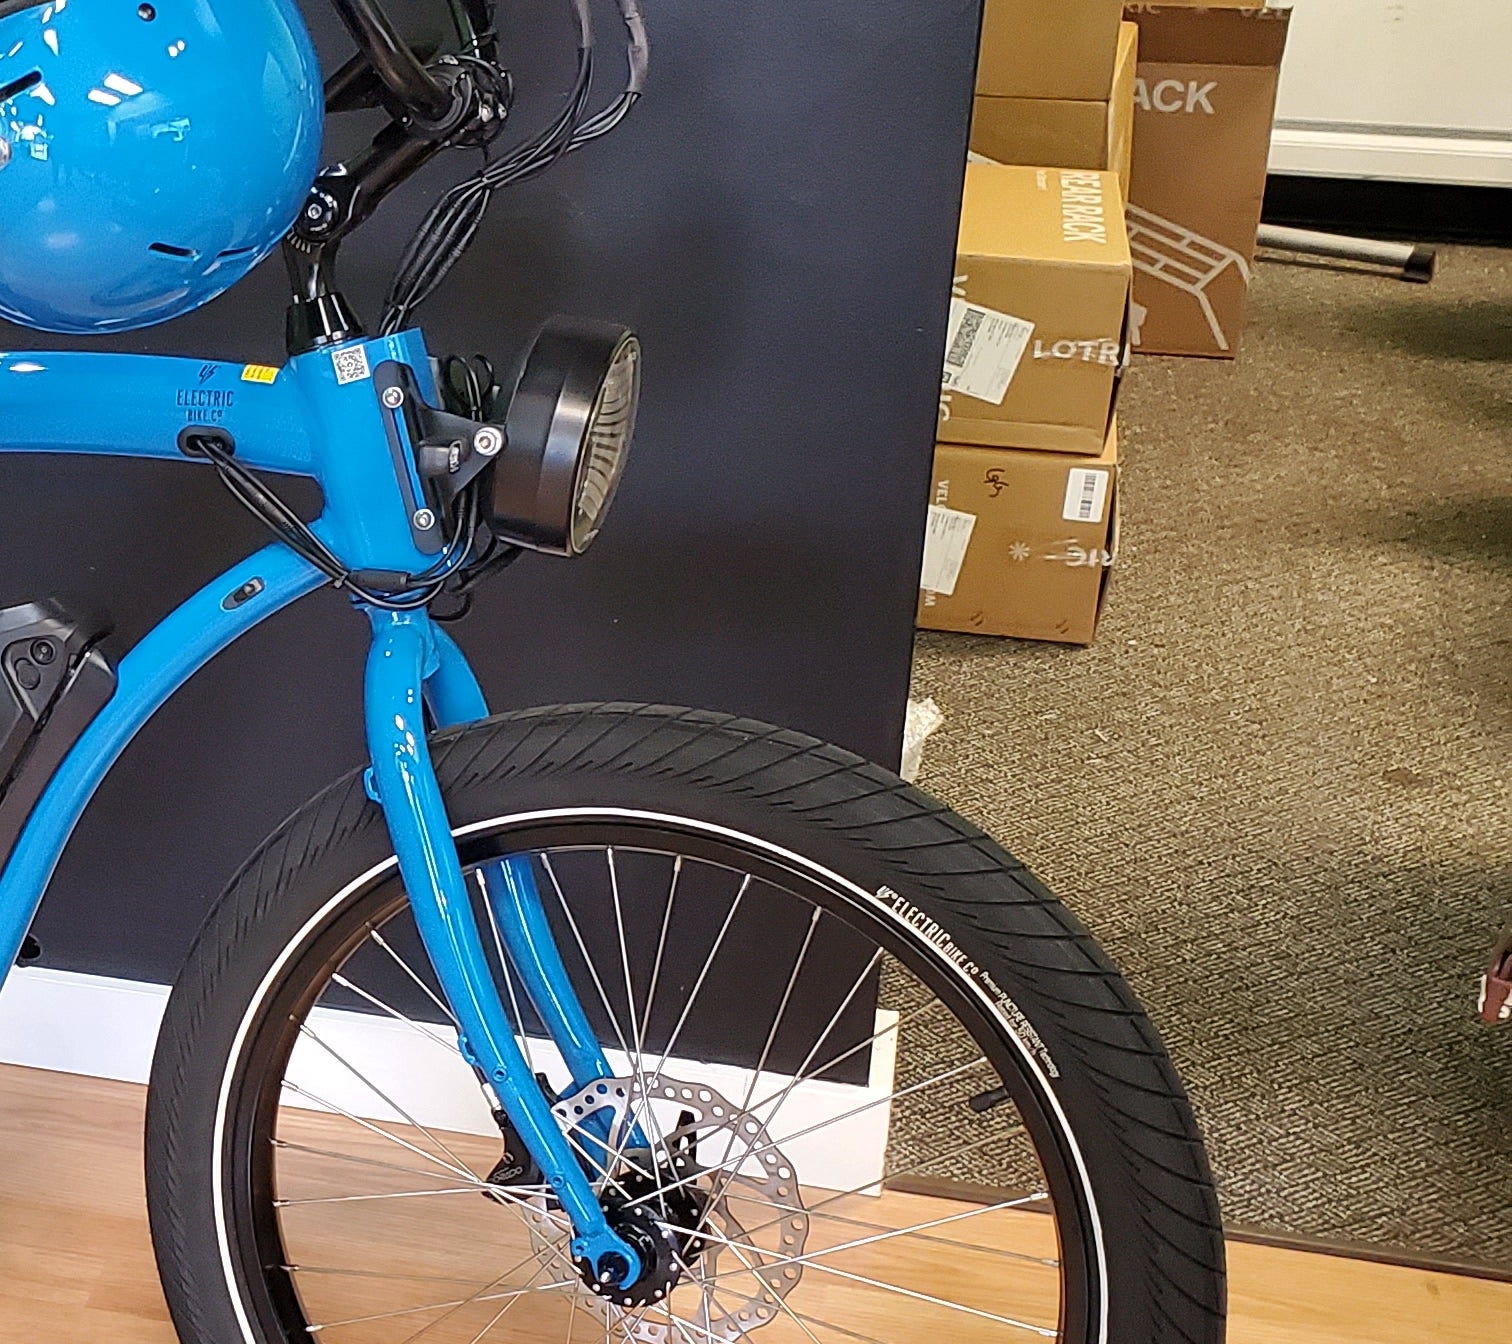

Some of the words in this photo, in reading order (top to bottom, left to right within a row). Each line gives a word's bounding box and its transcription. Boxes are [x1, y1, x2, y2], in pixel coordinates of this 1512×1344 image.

[1133, 77, 1218, 115] ACK
[1059, 171, 1103, 204] REAR
[1062, 204, 1107, 244] RACK
[177, 389, 234, 407] ELECTRIC
[187, 409, 210, 422] BIKE
[891, 896, 951, 948] ELECTRIC
[943, 941, 968, 967] BIKE
